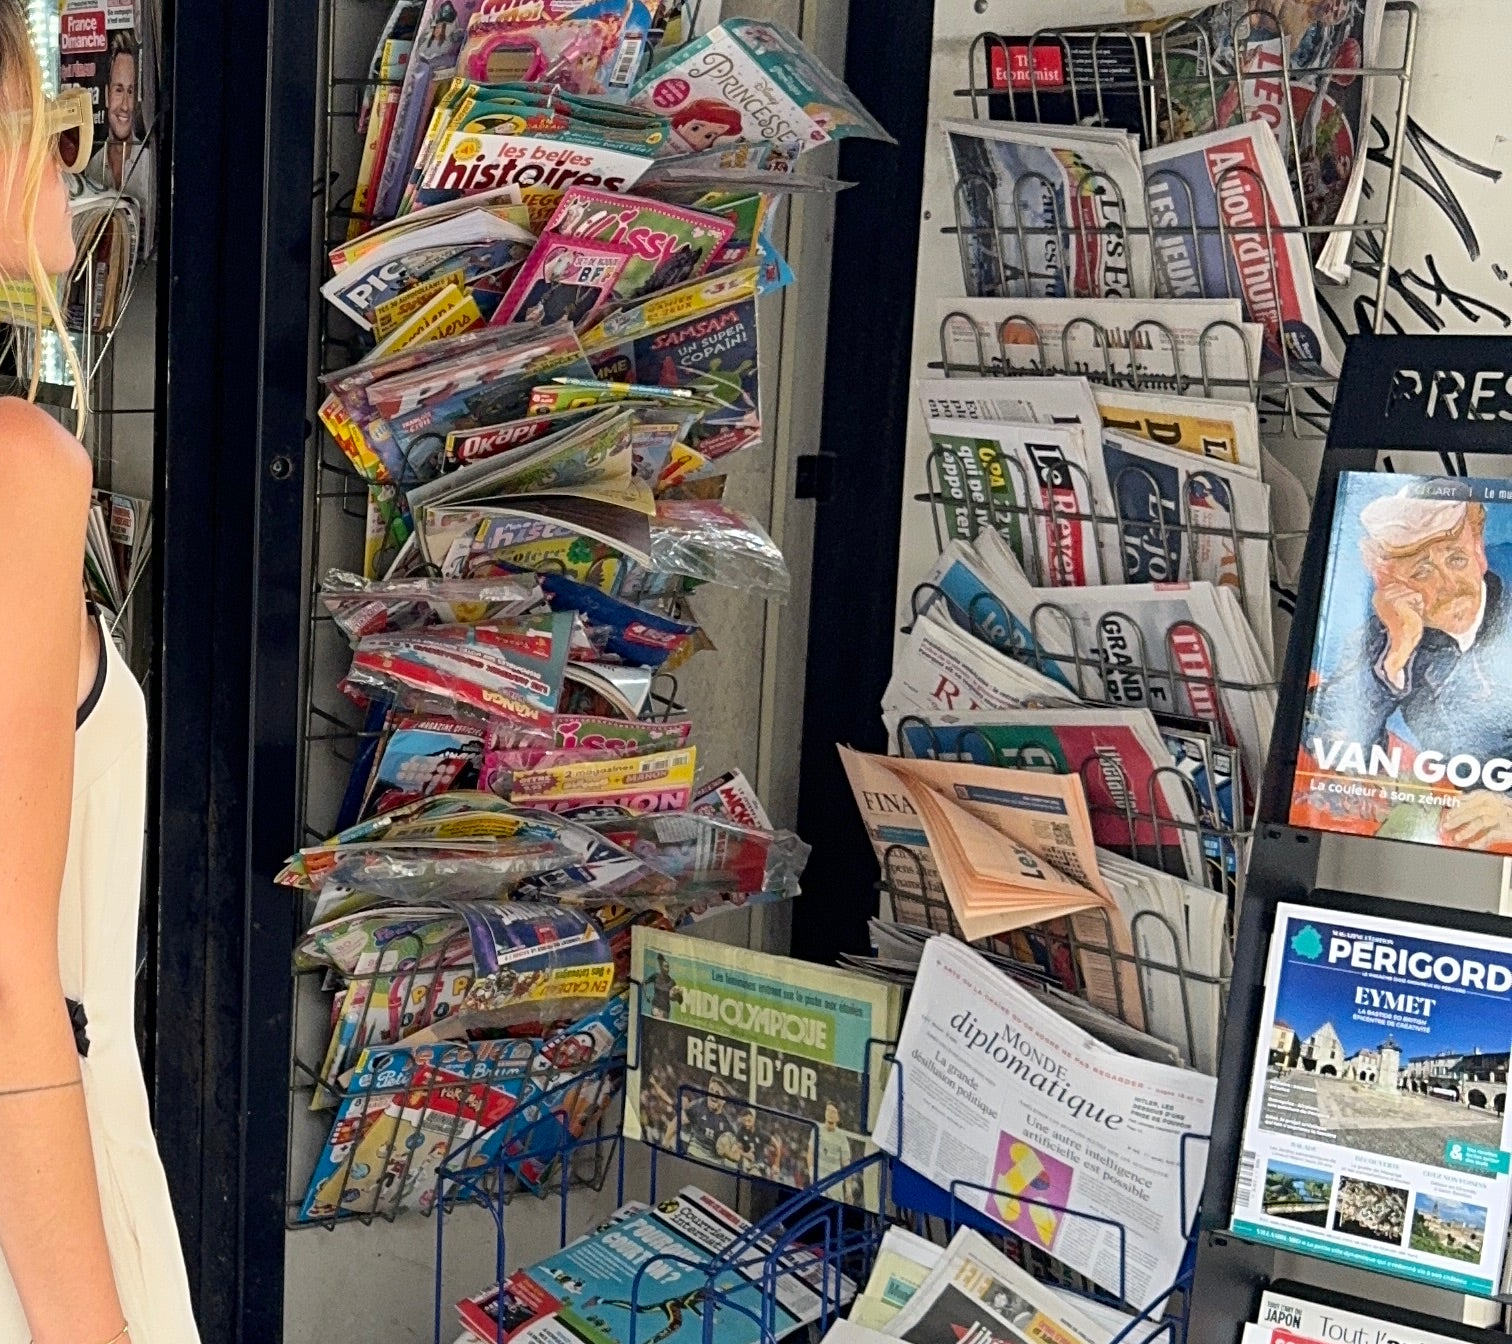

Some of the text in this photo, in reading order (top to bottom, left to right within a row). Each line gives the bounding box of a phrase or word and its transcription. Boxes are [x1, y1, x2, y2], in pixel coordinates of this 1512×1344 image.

[67, 16, 98, 32] France
[61, 31, 106, 49] Dimanche
[994, 66, 1063, 83] Economist
[498, 142, 594, 167] les belles
[1313, 738, 1512, 792] VAN GOG
[1310, 779, 1325, 790] La
[1329, 783, 1376, 797] couleur
[1391, 791, 1414, 802] son
[1419, 792, 1461, 807] zénith
[1355, 986, 1436, 1017] EYMET
[687, 1034, 817, 1102] RÊVE D'OR
[1000, 1023, 1069, 1082] MONDE
[949, 1010, 1124, 1131] diplomatique
[1022, 1127, 1151, 1202] artificielle est possible
[1026, 1113, 1154, 1190] Une autre intelligence
[1264, 1309, 1302, 1329] JAPON
